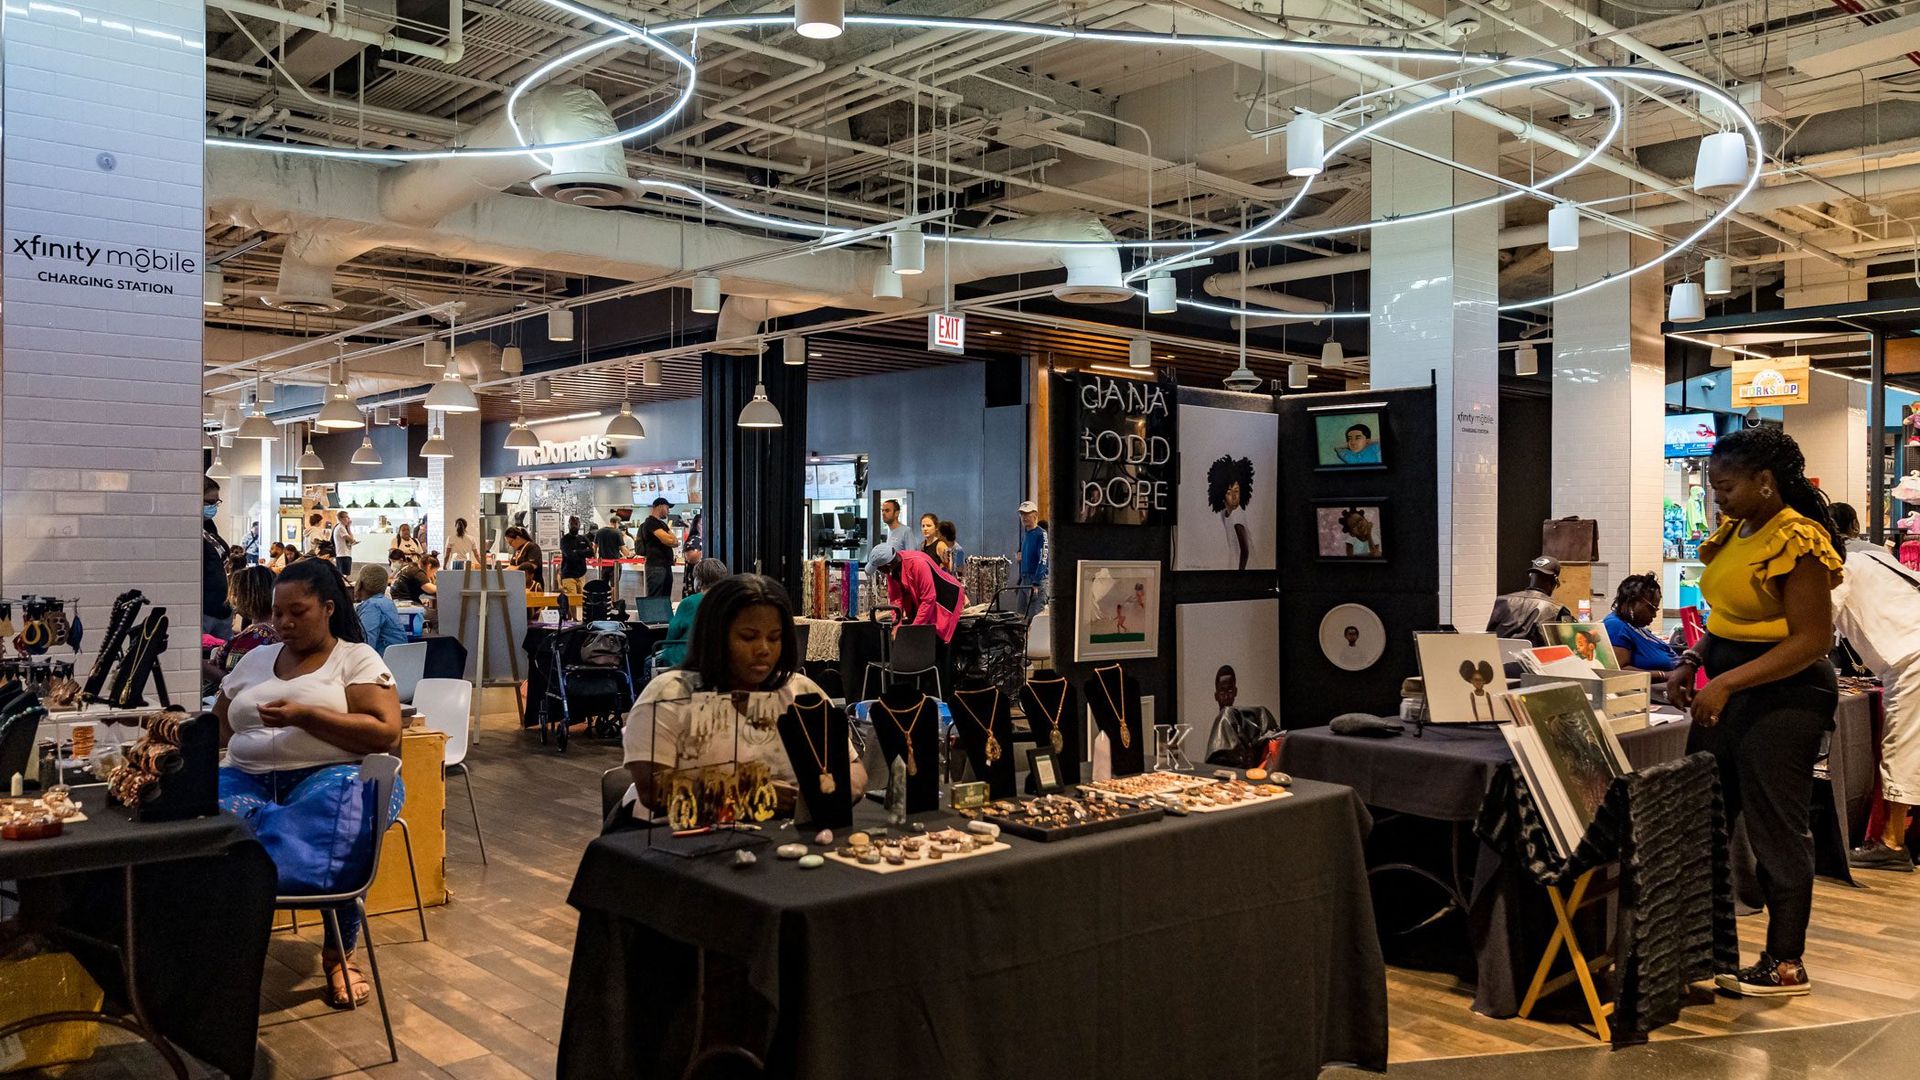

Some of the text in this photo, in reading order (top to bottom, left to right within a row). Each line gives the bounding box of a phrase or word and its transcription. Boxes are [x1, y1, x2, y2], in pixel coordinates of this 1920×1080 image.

[13, 235, 100, 266] xfinity
[38, 271, 173, 294] CHARGING STATION
[939, 315, 960, 340] EXIT
[1741, 384, 1797, 396] WORKSHOP
[1457, 411, 1474, 424] xfinity
[517, 434, 610, 466] McDonald's
